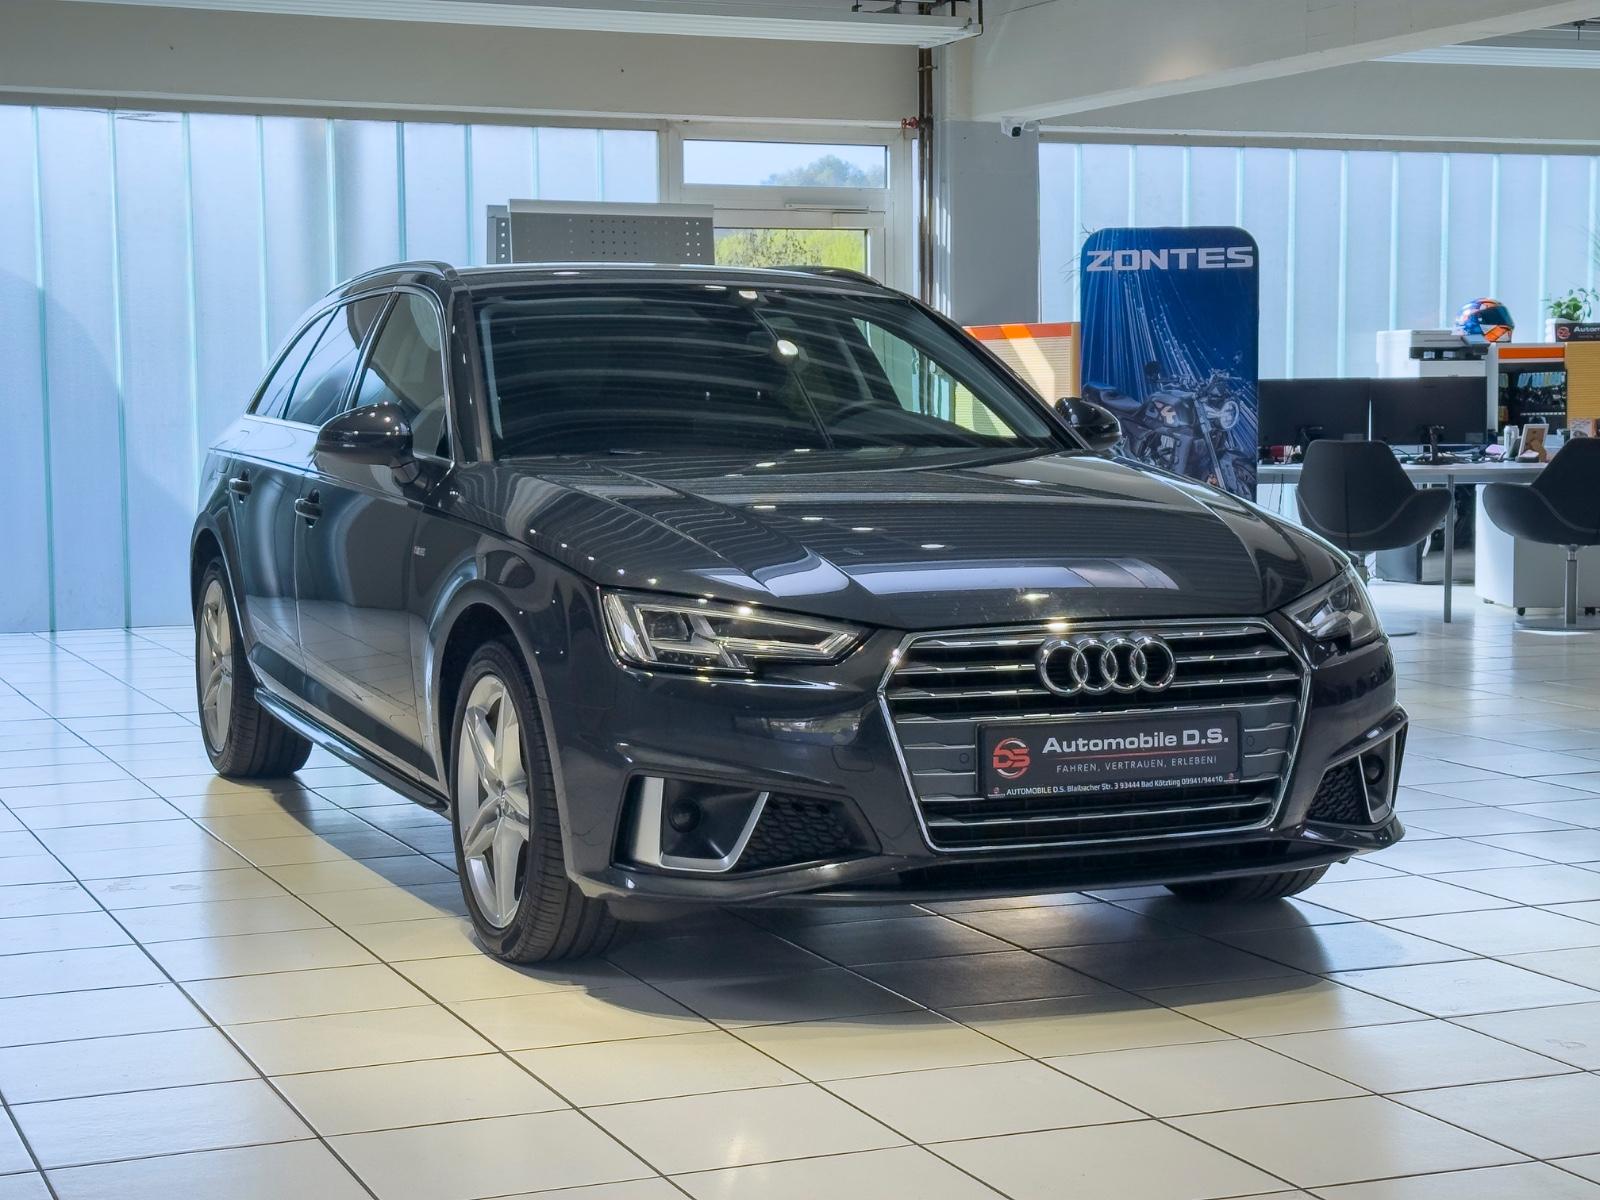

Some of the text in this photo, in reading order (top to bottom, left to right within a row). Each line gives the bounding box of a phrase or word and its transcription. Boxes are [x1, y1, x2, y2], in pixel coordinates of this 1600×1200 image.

[1087, 246, 1254, 272] ZONTES
[1042, 728, 1229, 754] Automobile D.S.
[1056, 756, 1217, 774] FAHREN, VERTRAUEN, ERLEBEN!
[1006, 786, 1052, 796] AUTOMOBILE
[1101, 782, 1114, 790] Str.
[1120, 780, 1140, 789] 93444
[1141, 780, 1154, 788] Bad
